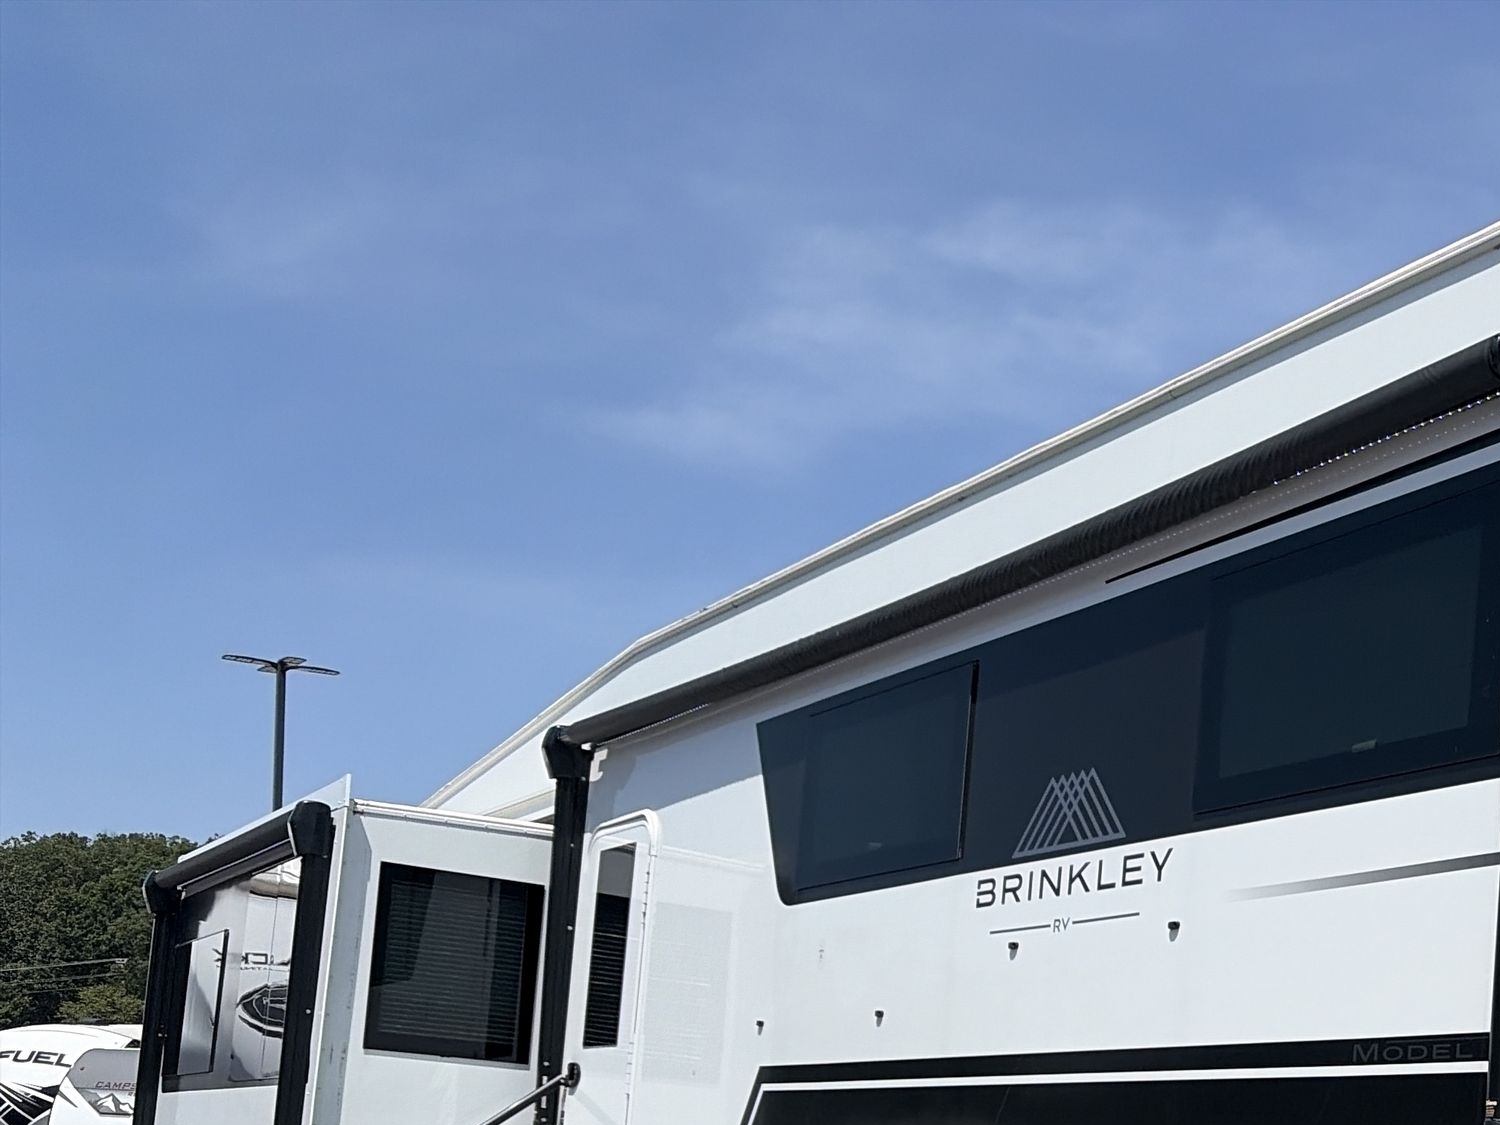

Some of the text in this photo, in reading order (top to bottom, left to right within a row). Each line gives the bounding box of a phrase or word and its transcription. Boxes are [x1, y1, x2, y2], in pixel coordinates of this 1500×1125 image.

[975, 848, 1174, 909] BRINKLEY
[1052, 917, 1071, 934] RV
[0, 1050, 72, 1068] FUEL
